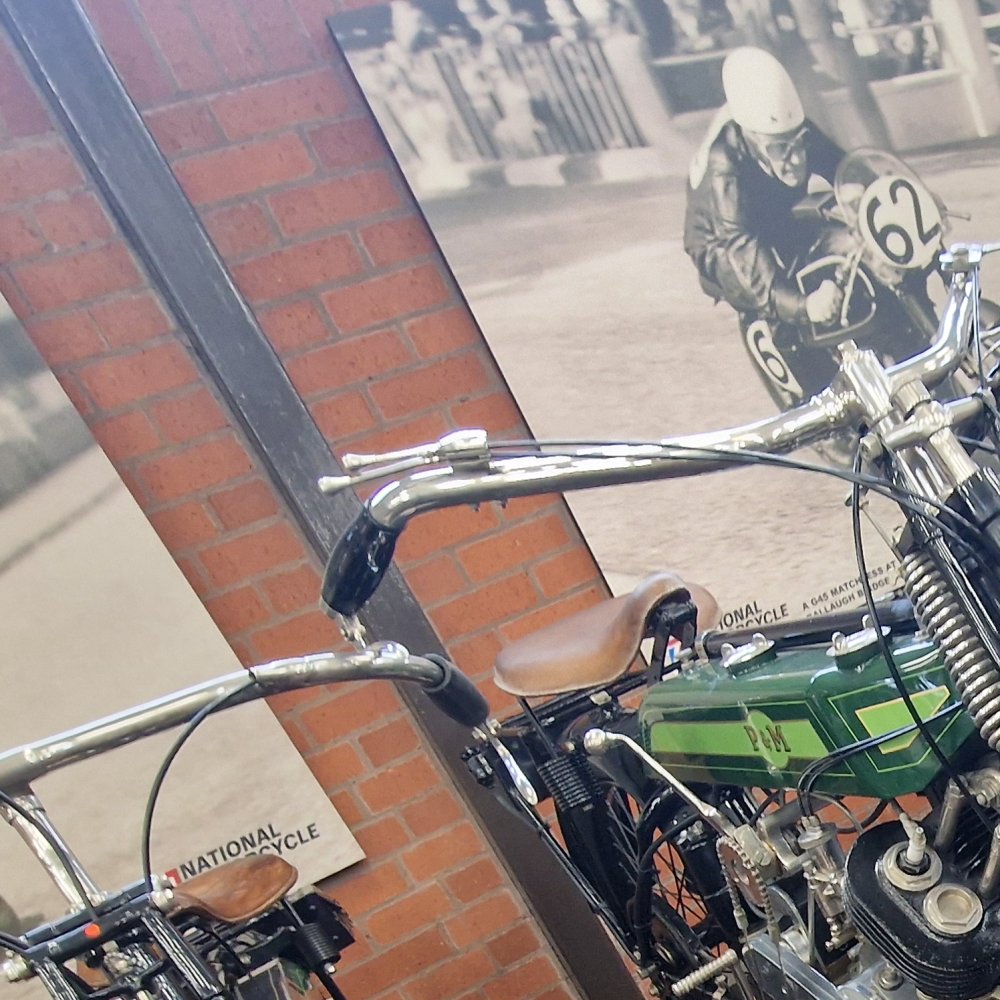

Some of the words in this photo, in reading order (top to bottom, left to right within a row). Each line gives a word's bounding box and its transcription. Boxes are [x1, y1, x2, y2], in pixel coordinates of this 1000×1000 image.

[866, 179, 941, 265] 62
[753, 329, 789, 385] 6
[810, 593, 829, 609] G45
[831, 567, 884, 600] MATCHESS
[886, 560, 897, 574] AT
[180, 823, 281, 880] NATIONAL
